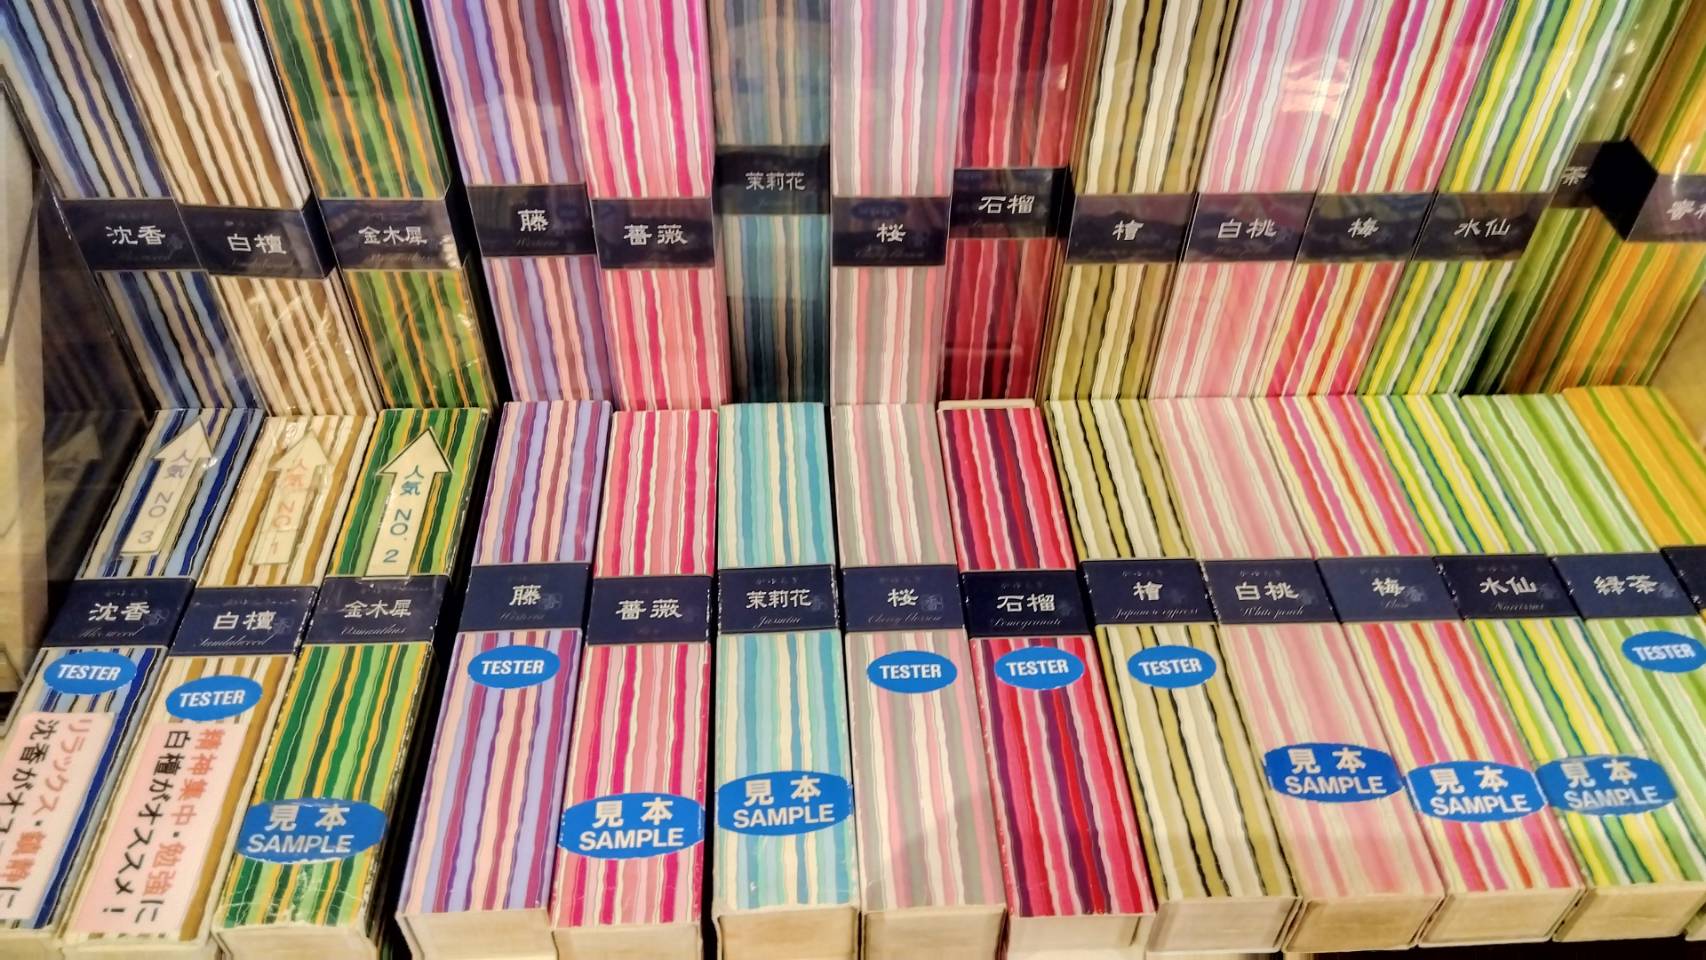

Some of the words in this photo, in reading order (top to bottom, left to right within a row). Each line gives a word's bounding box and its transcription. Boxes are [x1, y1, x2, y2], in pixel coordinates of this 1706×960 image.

[745, 172, 807, 193] 茉莉花
[978, 194, 1035, 215] 石榴
[517, 209, 549, 232] 藤
[1112, 220, 1145, 241] 檜
[1217, 218, 1278, 239] 白桃
[1347, 217, 1380, 238] 梅
[1453, 217, 1511, 237] 水仙
[105, 225, 166, 246] 沈香
[358, 226, 429, 245] 金木犀
[623, 224, 689, 246] 薔薇
[876, 222, 907, 243] 桜
[227, 233, 287, 254] 白檀
[163, 450, 193, 480] 人気
[400, 464, 424, 496] 人気
[389, 508, 413, 541] NO.
[137, 530, 155, 545] 3
[270, 542, 279, 555] 1
[383, 549, 400, 563] 2
[509, 584, 541, 606] 藤
[1133, 581, 1163, 601] 檜
[1235, 581, 1300, 601] 白桃
[1371, 577, 1406, 597] 梅
[1480, 575, 1538, 597] 水仙
[1593, 575, 1658, 596] 緑茶
[745, 588, 812, 609] 茉莉花
[887, 588, 919, 608] 桜
[996, 593, 1056, 613] 石榴
[88, 602, 151, 621] 沈香
[344, 599, 411, 619] 金木犀
[615, 598, 684, 620] 薔薇
[213, 610, 277, 631] 白檀
[1632, 643, 1697, 662] TESTER
[57, 664, 121, 681] TESTER
[481, 659, 545, 676] TESTER
[879, 663, 942, 680] TESTER
[1005, 659, 1069, 677] TESTER
[1138, 657, 1203, 676] TESTER
[179, 689, 246, 708] TESTER
[1286, 747, 1367, 774] 見本
[1429, 767, 1508, 795] 見本
[1559, 759, 1638, 789] 見本
[744, 776, 821, 807] 見本
[1284, 775, 1387, 796] SAMPLE
[1428, 794, 1533, 816] SAMPLE
[1564, 786, 1664, 811] SAMPLE
[264, 803, 350, 832] 見本
[592, 797, 674, 829] 見本
[733, 803, 835, 828] SAMPLE
[134, 728, 226, 923] 精神集中・勉強に
[247, 834, 355, 854] SAMPLE
[578, 827, 685, 852] SAMPLE
